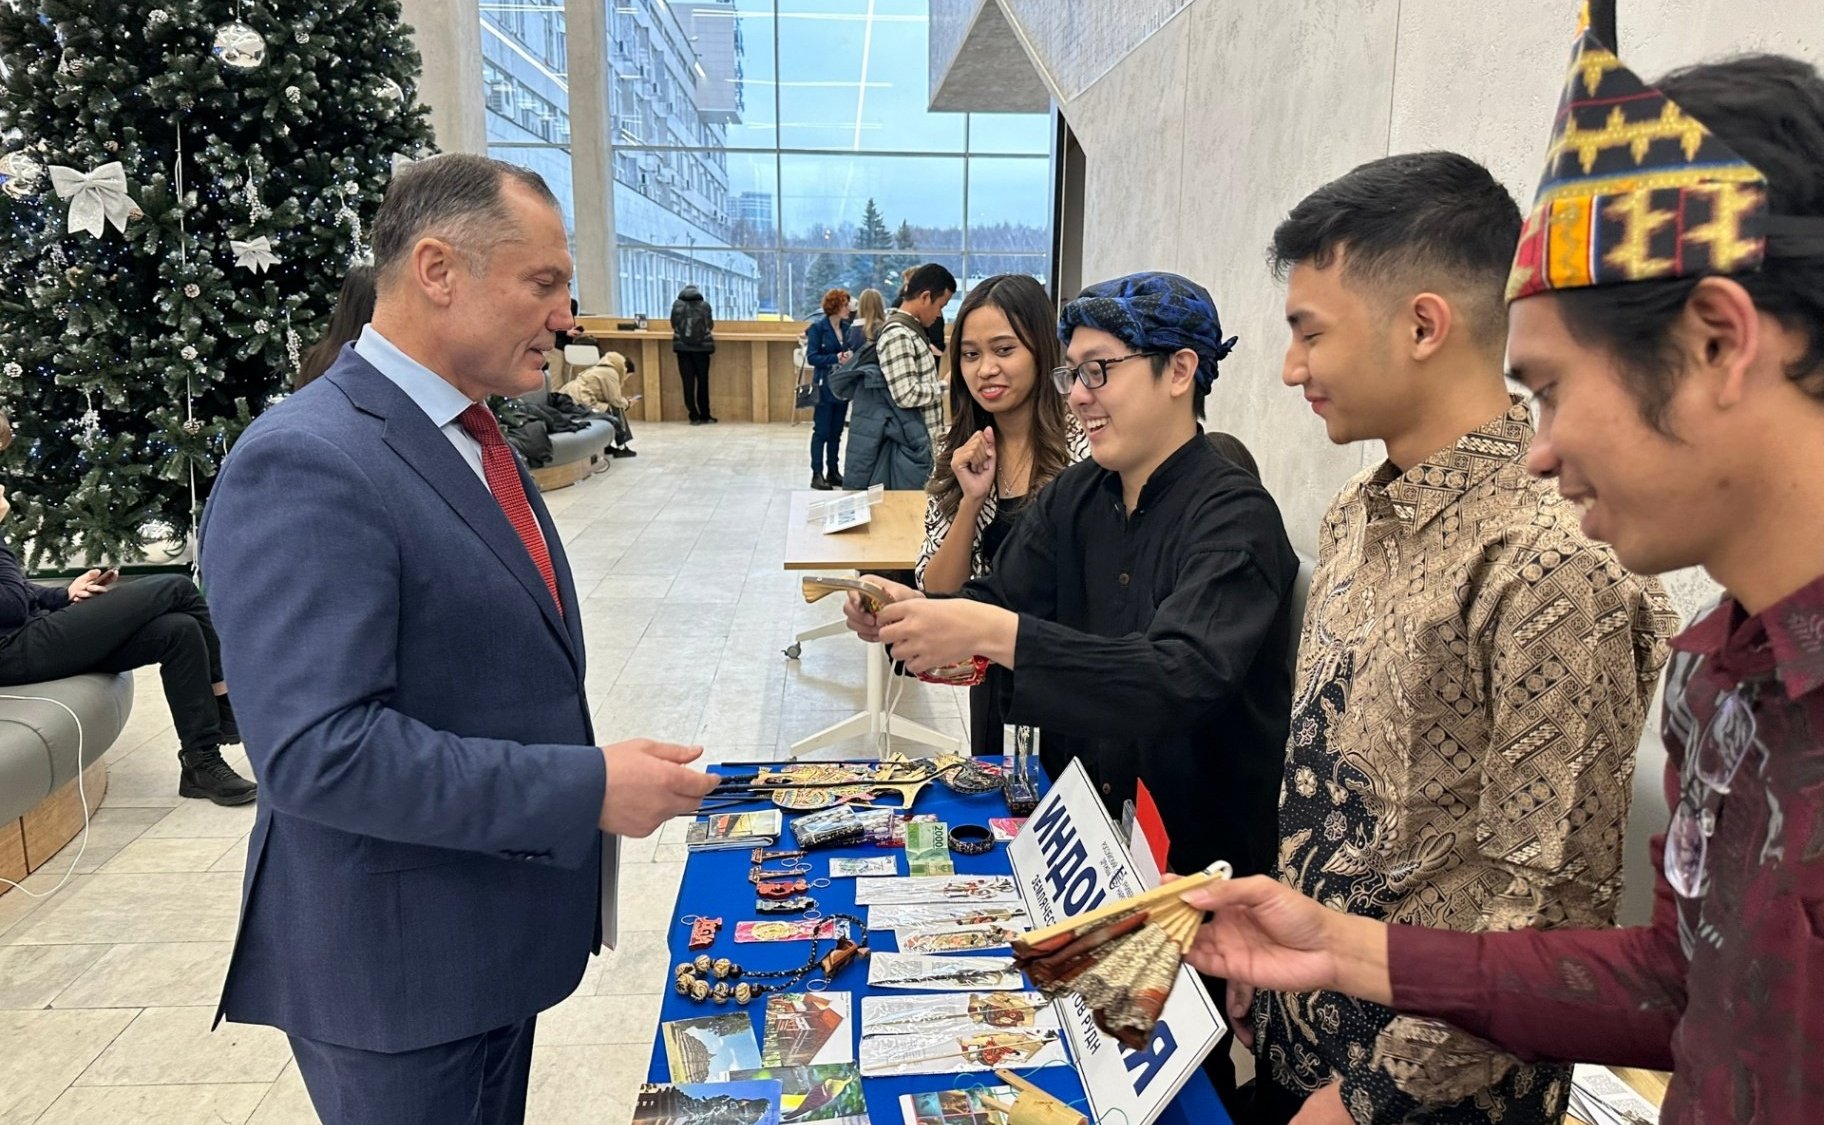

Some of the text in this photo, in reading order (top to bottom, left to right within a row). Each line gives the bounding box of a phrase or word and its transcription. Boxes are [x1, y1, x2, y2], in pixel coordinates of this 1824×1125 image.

[1031, 873, 1101, 1055] ЗЕМЛЯЧЕС РУДН
[1033, 794, 1178, 1097] ИНДОЯ
